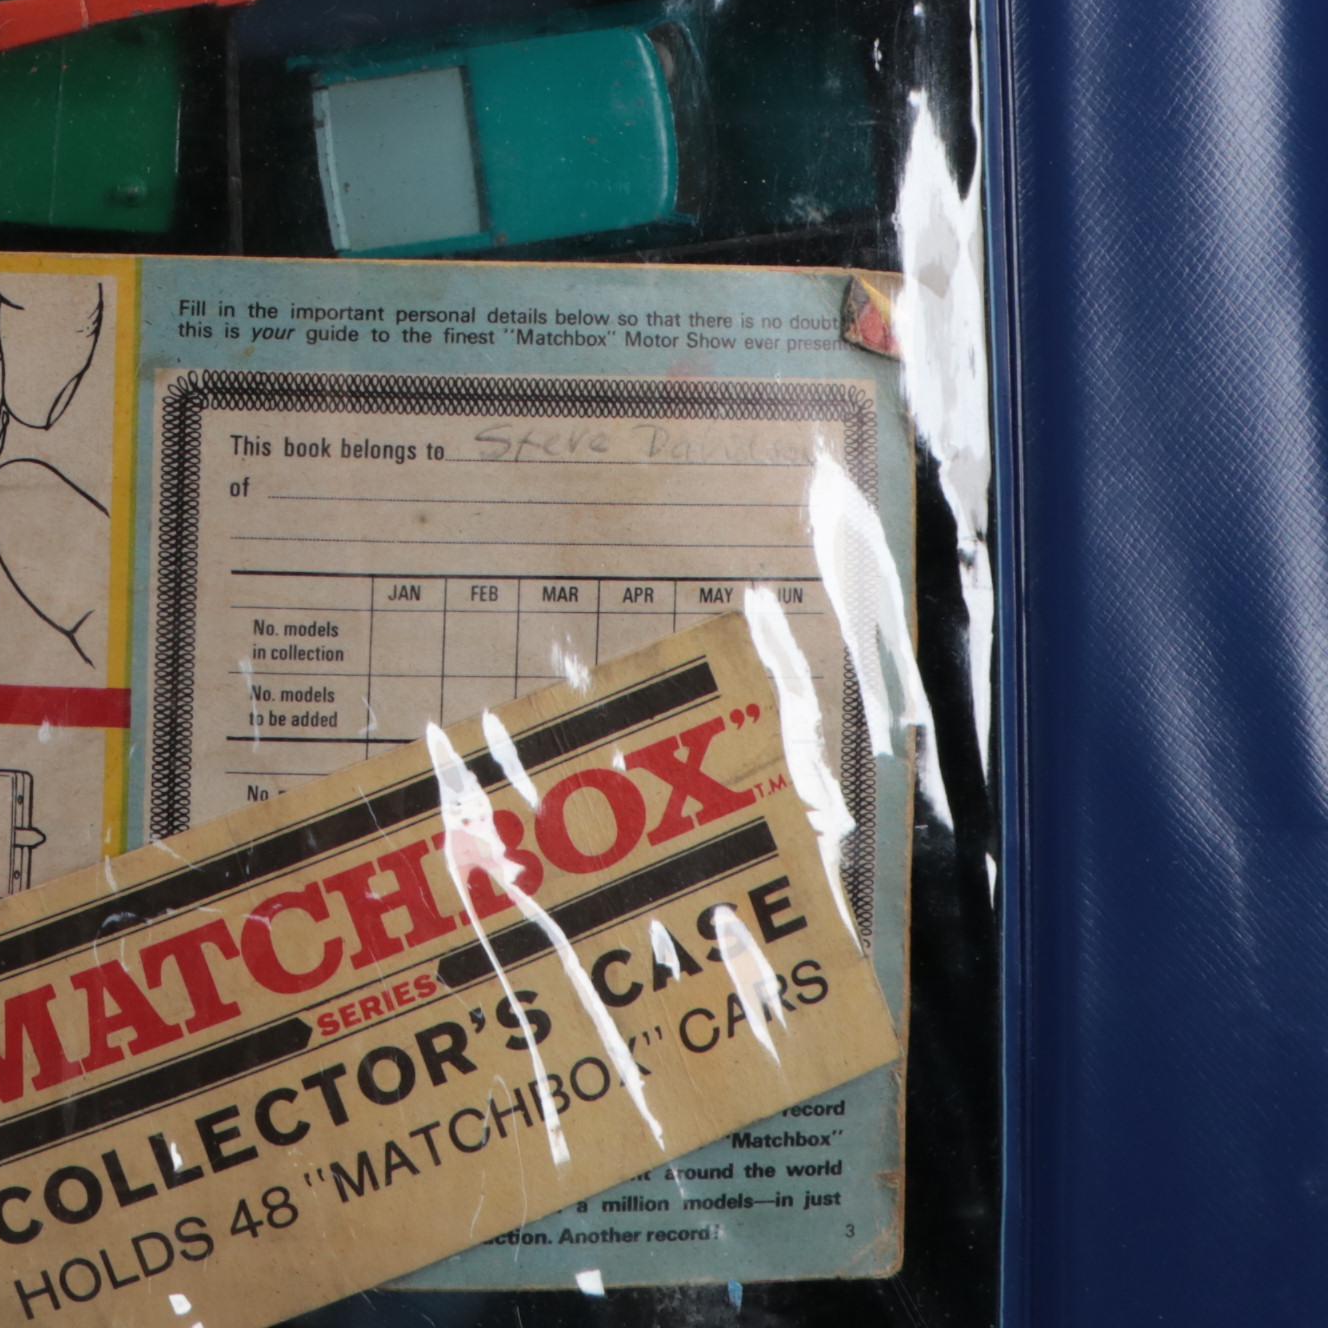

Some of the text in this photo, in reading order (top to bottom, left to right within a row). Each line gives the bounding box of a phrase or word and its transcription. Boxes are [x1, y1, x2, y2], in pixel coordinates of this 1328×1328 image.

[179, 300, 839, 331] Fill in the important personal details below so that there is no doubt
[178, 322, 212, 339] this
[225, 323, 239, 340] is
[250, 326, 296, 342] your
[306, 325, 359, 346] guide
[372, 328, 390, 344] to
[402, 327, 432, 344] the
[444, 328, 495, 345] finest
[504, 328, 615, 348] "Matchbox"
[625, 331, 679, 349] Motor
[686, 331, 736, 350] Show
[744, 336, 779, 351] ever
[230, 435, 445, 465] This book belongs to
[475, 423, 609, 463] Steve
[230, 477, 250, 497] of
[388, 585, 421, 601] JAN
[471, 585, 499, 602] FEB
[542, 586, 579, 603] MAR
[623, 587, 654, 604] APR
[699, 587, 734, 604] MAY
[253, 619, 339, 638] No. models
[253, 644, 344, 662] in collection
[251, 685, 335, 703] No. models
[249, 711, 338, 728] to be added
[318, 975, 438, 1037] SERIES
[782, 1100, 845, 1118] record
[664, 1163, 734, 1180] around
[744, 1162, 776, 1178] the
[786, 1160, 842, 1177] world
[576, 1201, 588, 1213] a
[602, 1195, 669, 1212] million
[803, 1191, 842, 1210] just
[558, 1227, 640, 1245] Another
[845, 1223, 856, 1238] 3
[14, 1217, 214, 1320] HOLDS
[229, 1185, 299, 1240] 48
